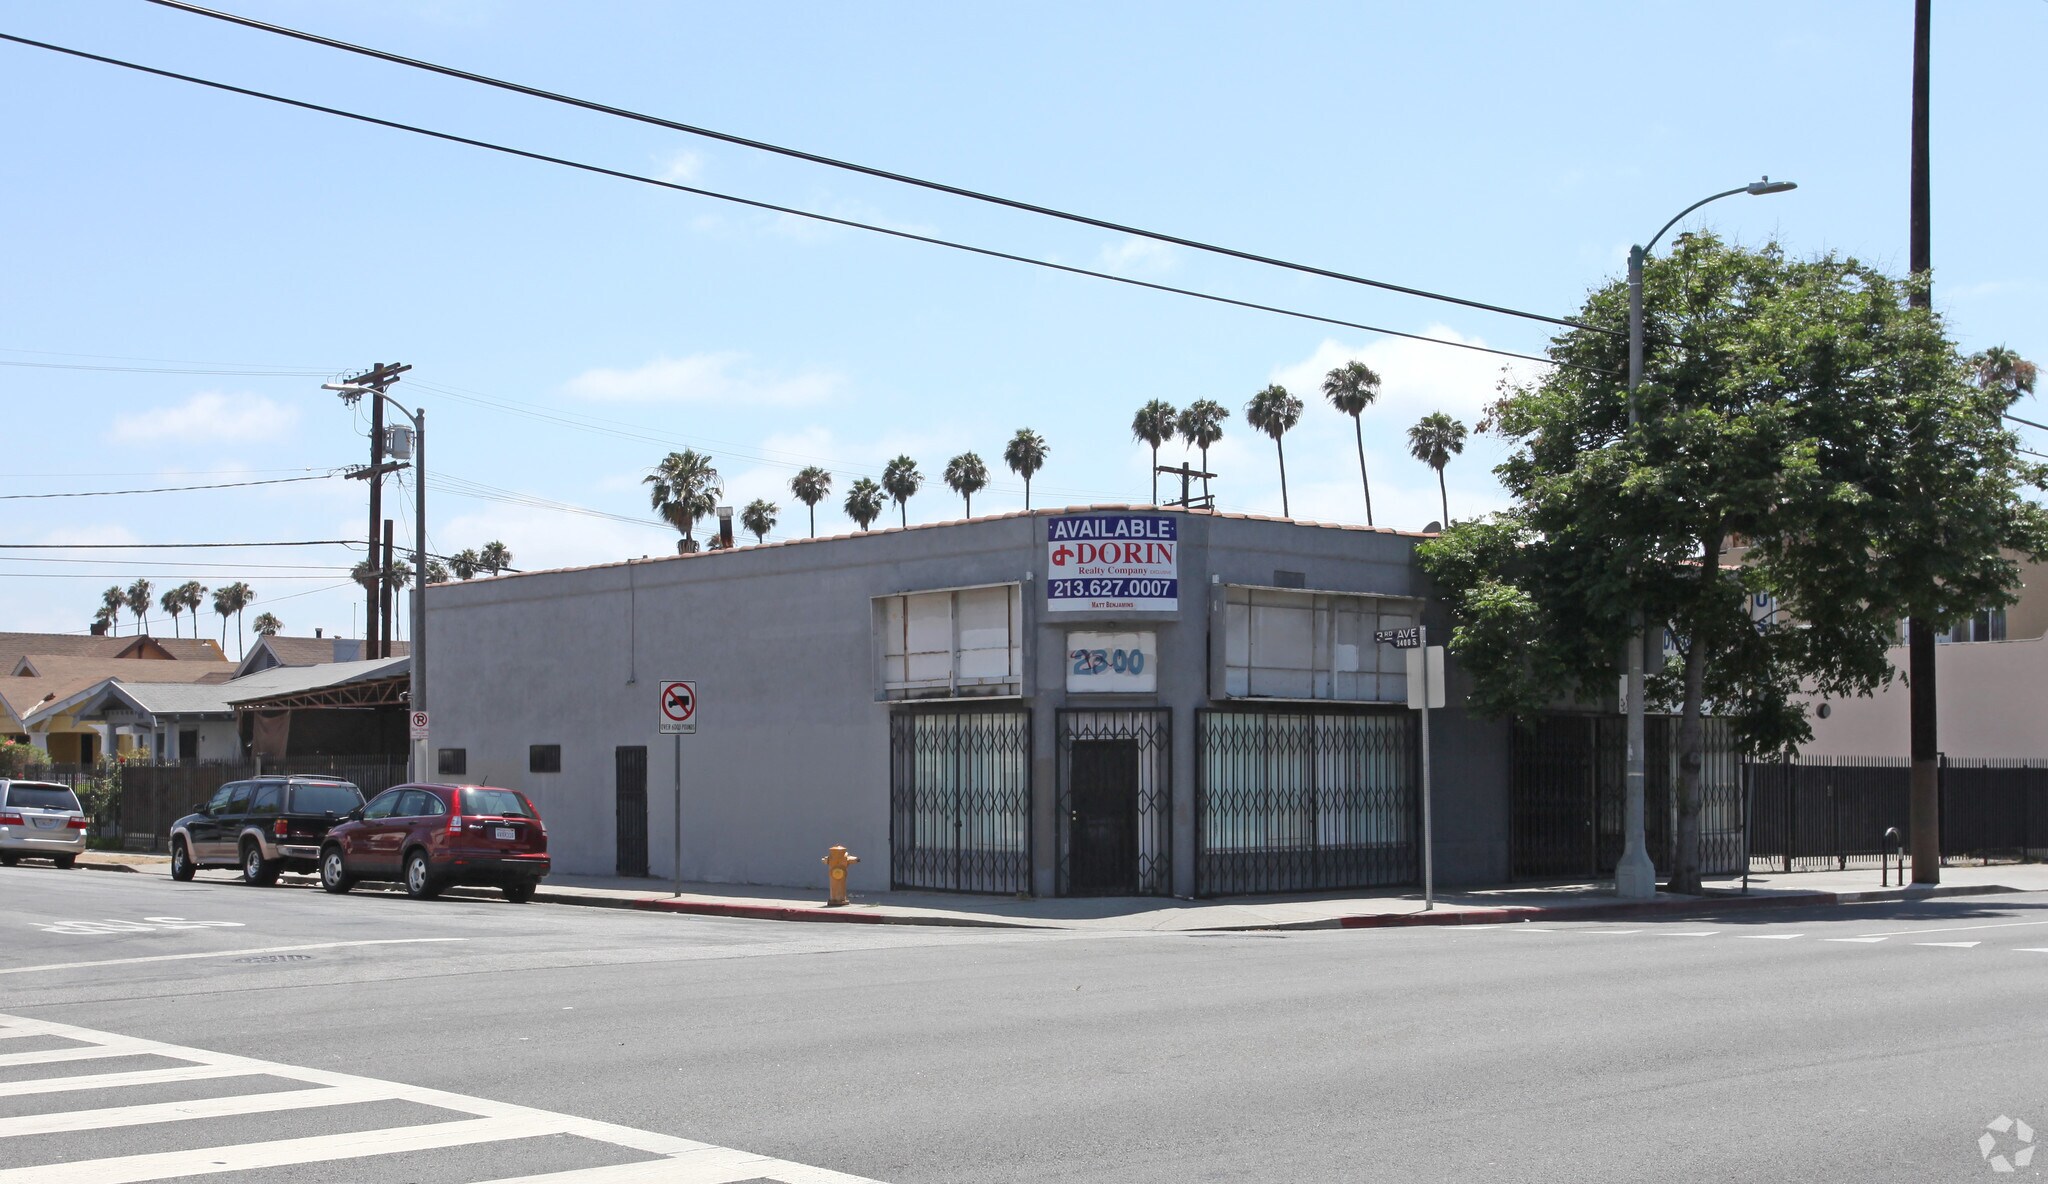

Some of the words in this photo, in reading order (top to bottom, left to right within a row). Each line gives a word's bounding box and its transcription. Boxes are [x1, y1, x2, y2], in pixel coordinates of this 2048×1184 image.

[1054, 519, 1170, 538] AVAILABLE
[1076, 542, 1174, 565] DORIN
[1078, 566, 1105, 576] Realty
[1107, 566, 1148, 576] Company
[1054, 579, 1171, 597] 213.627.0007
[1397, 628, 1418, 638] AVE
[1396, 638, 1411, 647] 3400
